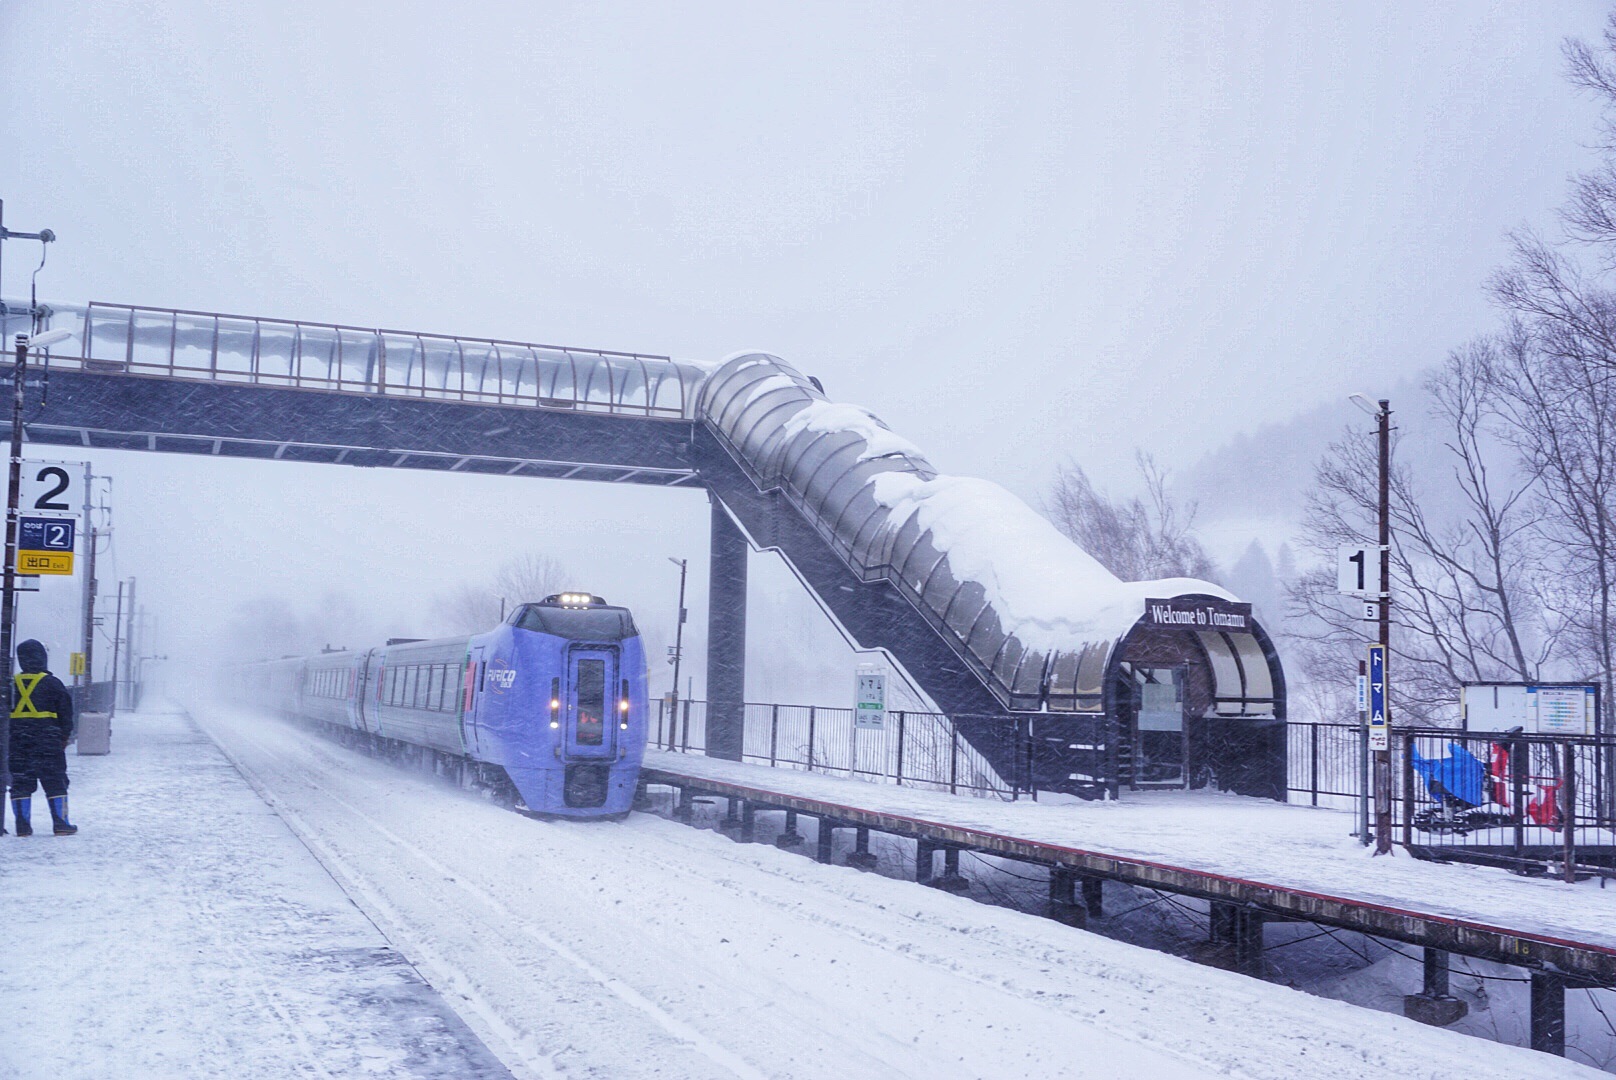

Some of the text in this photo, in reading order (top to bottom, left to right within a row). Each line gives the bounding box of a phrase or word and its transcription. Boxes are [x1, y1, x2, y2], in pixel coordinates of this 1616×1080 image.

[34, 466, 70, 511] 2
[50, 525, 65, 546] 2
[27, 557, 50, 568] 出口
[1349, 550, 1364, 590] 1
[1152, 604, 1246, 628] Welcome to Tomamu
[1366, 605, 1374, 618] 5
[1372, 652, 1384, 722] トマム
